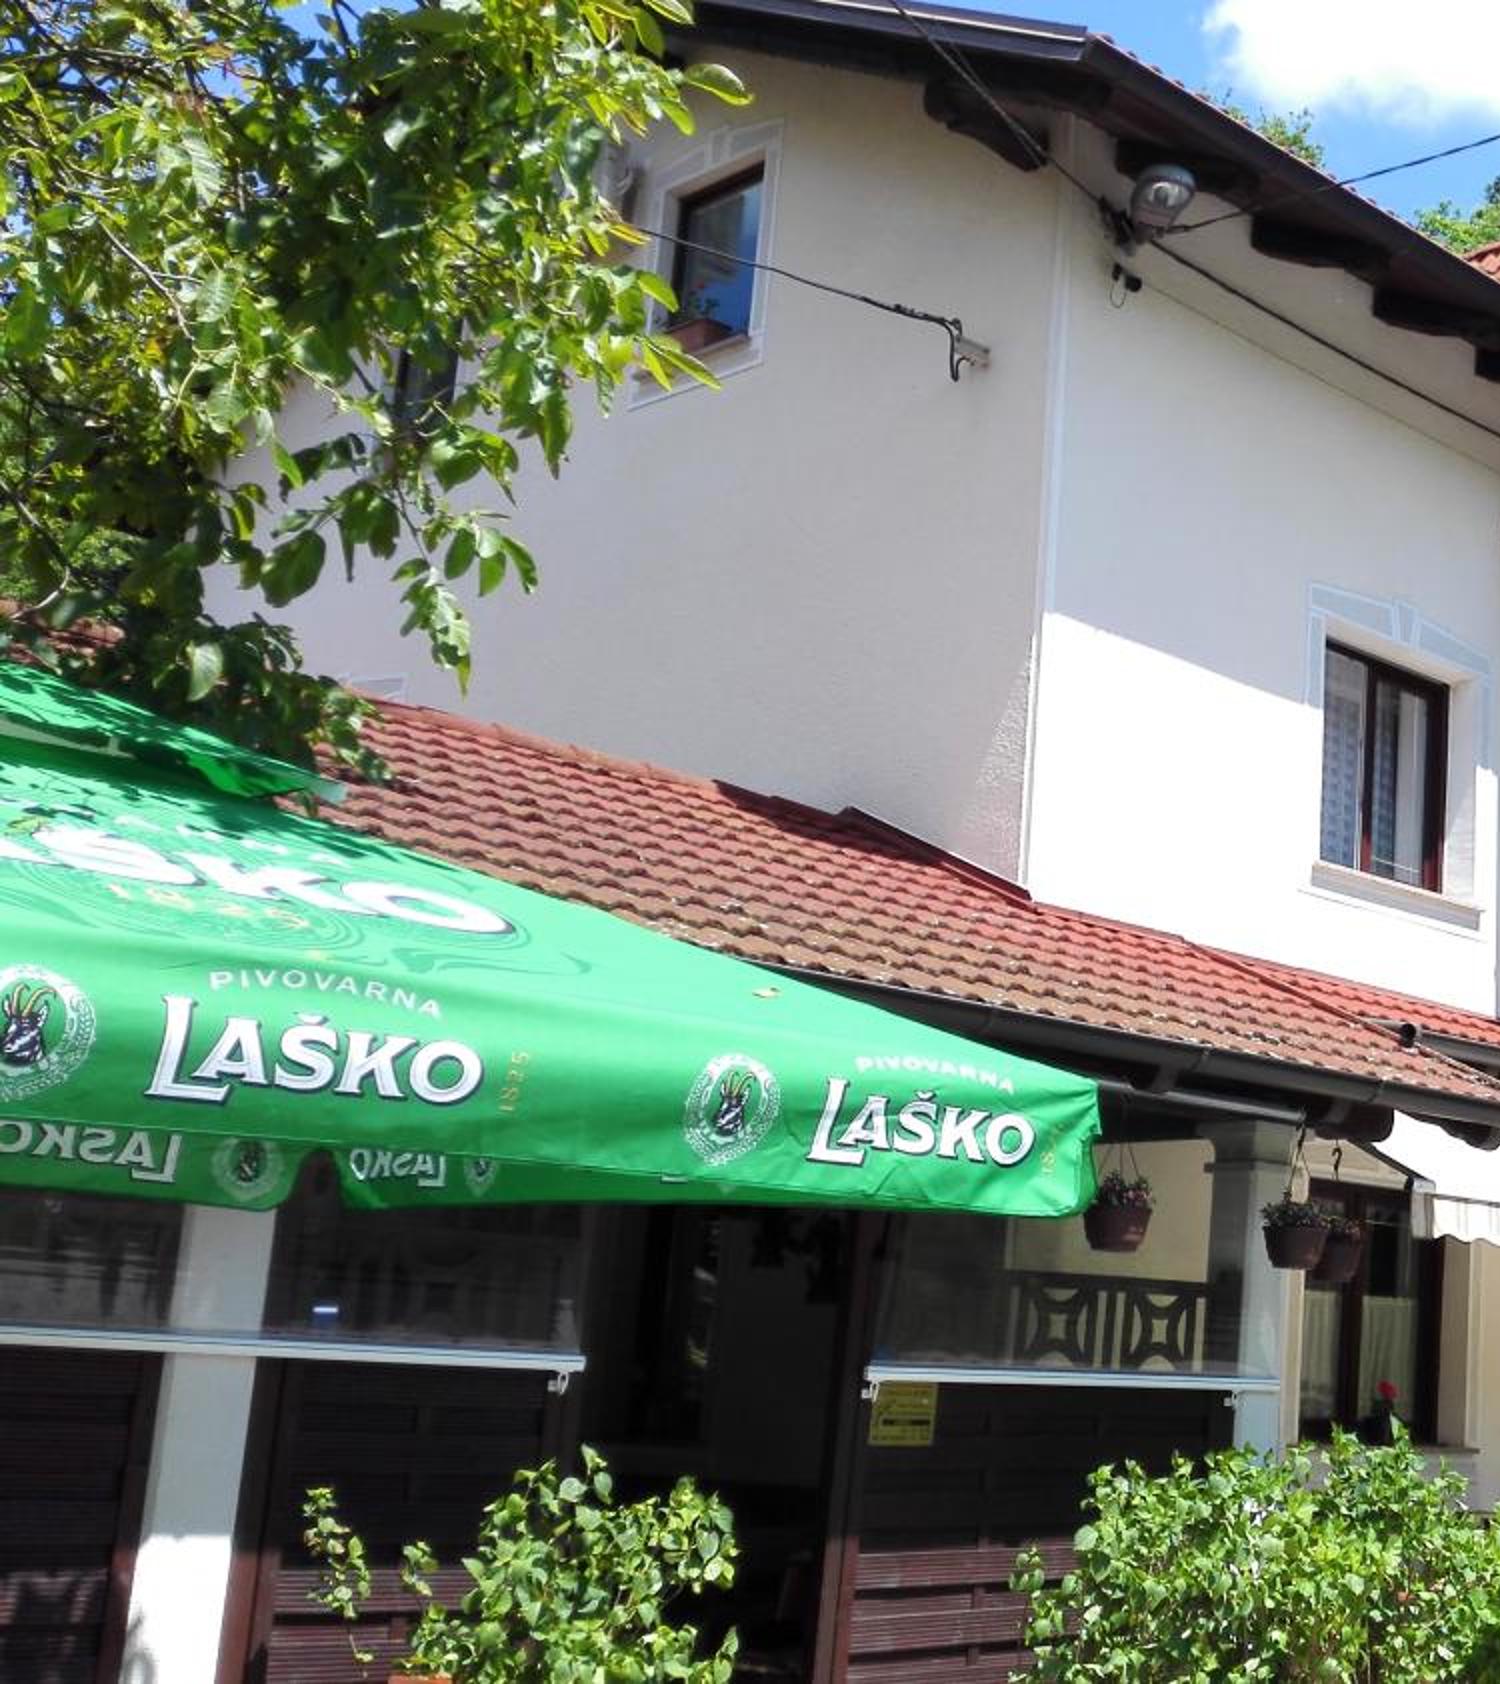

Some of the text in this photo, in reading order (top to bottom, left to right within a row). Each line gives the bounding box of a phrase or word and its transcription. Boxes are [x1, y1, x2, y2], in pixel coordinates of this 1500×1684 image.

[207, 969, 443, 1018] PIVOVARNA
[144, 994, 485, 1105] LAŠKO
[854, 1055, 1016, 1095] PIVOVARNA
[806, 1076, 1036, 1168] LAŠKO
